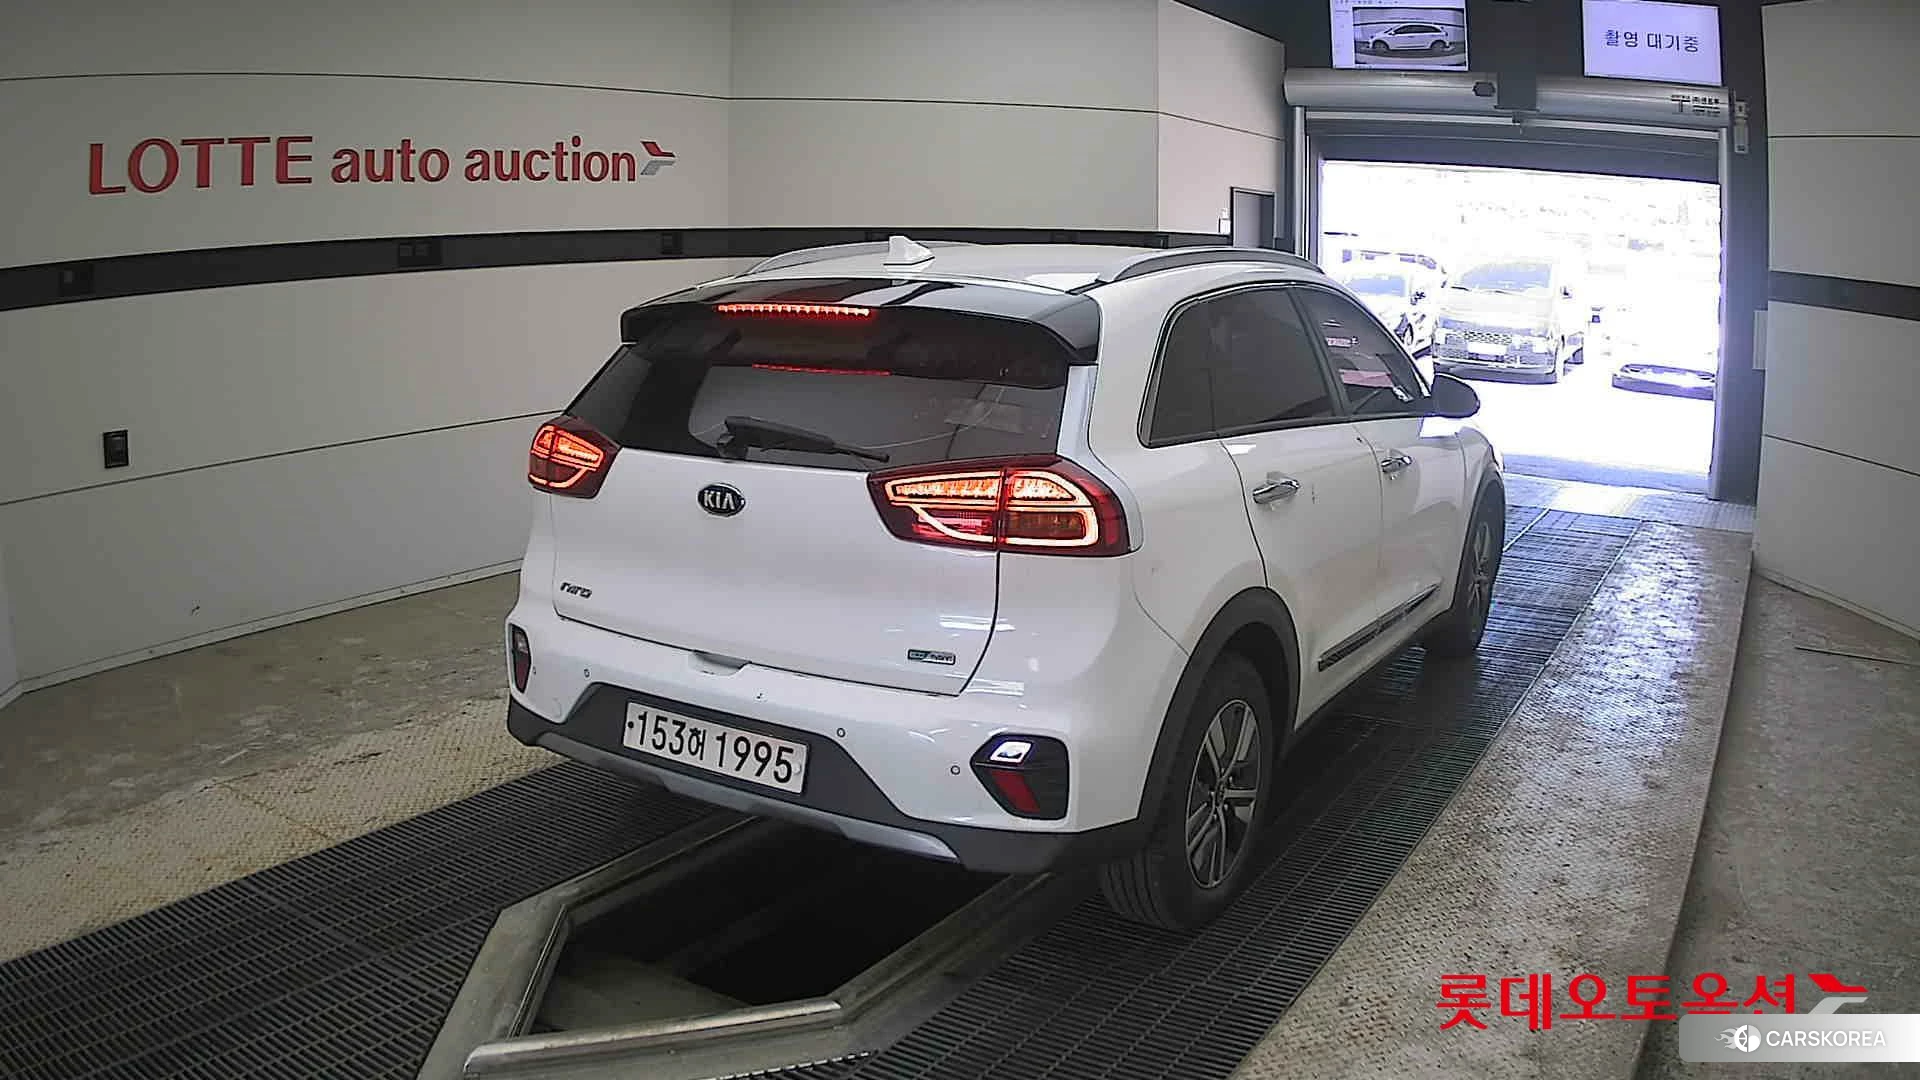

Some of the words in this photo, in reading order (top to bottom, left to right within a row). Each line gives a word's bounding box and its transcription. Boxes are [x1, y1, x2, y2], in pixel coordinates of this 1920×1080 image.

[1646, 33, 1699, 53] 대기중
[88, 136, 313, 195] LOTTE
[330, 138, 450, 183] auto
[463, 136, 636, 184] auction
[703, 489, 736, 510] KIA
[715, 731, 795, 784] 1995
